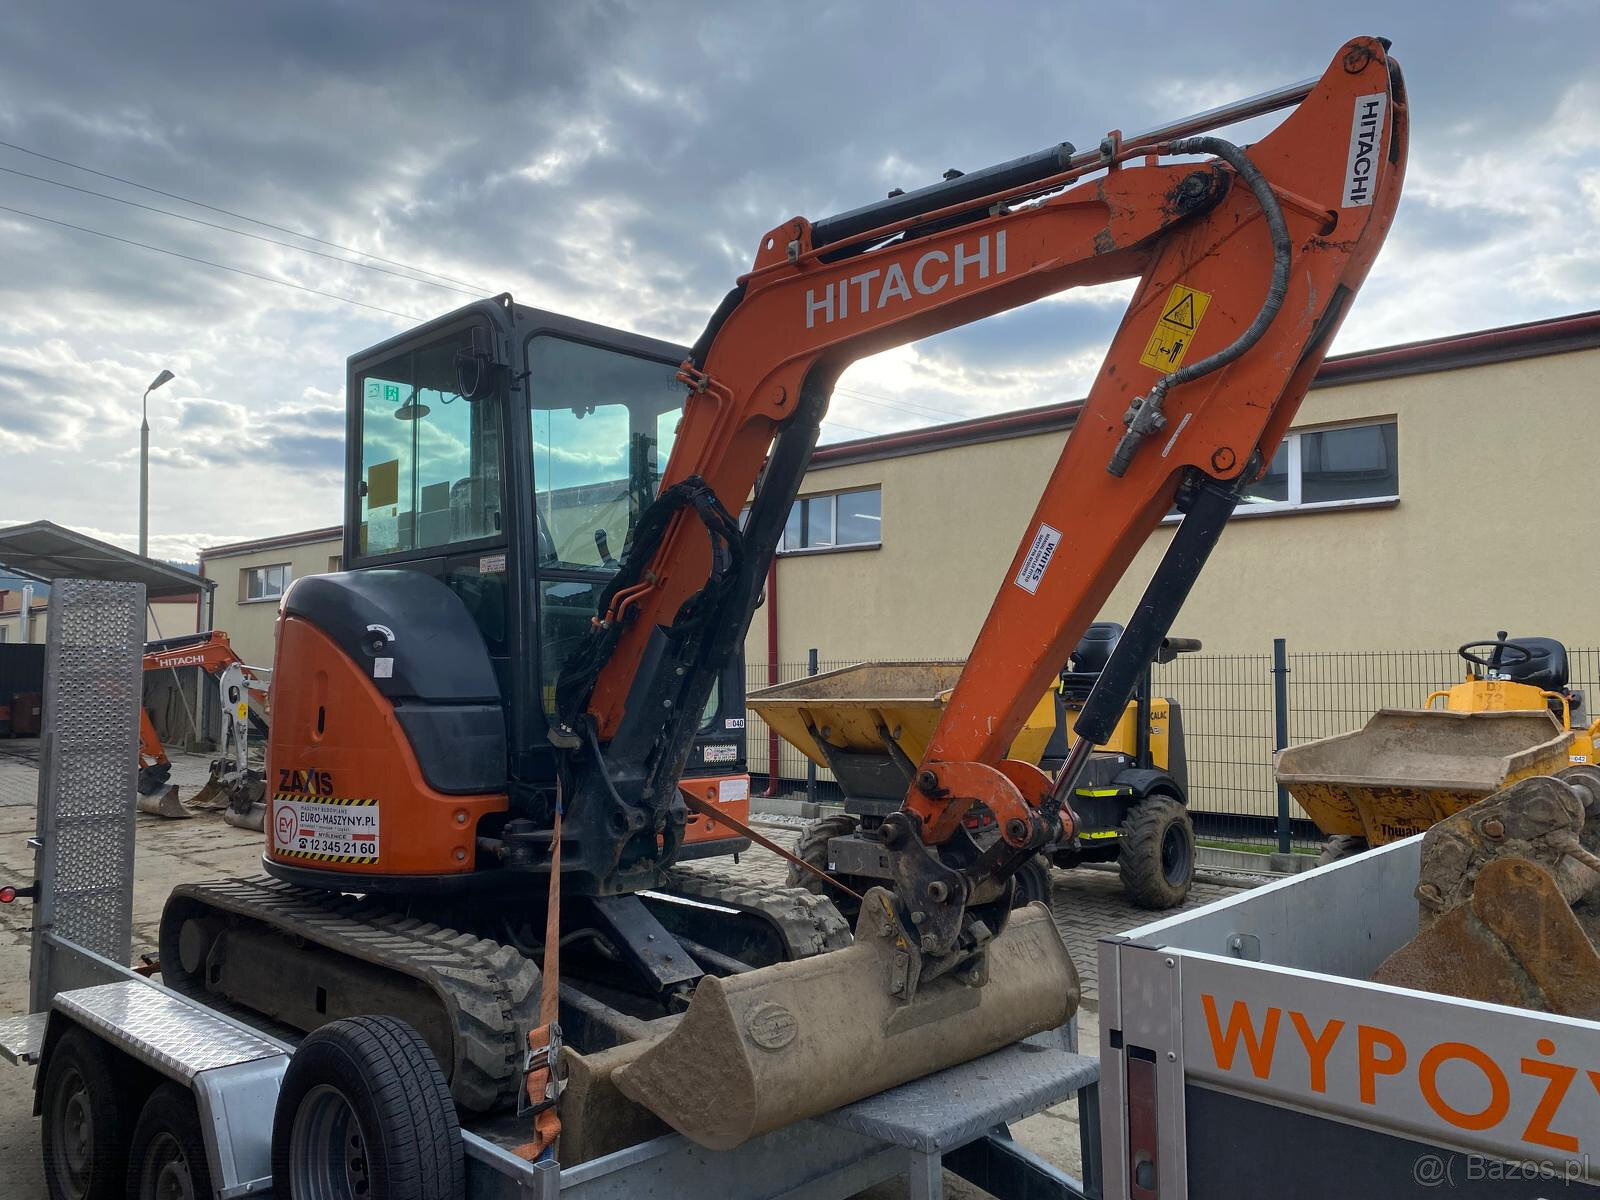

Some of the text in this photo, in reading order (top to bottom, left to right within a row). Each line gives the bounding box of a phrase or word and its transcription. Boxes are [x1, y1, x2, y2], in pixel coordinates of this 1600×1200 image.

[1350, 101, 1379, 201] HITACHI
[806, 229, 1007, 329] HITACHI
[1032, 543, 1055, 582] WHITES
[160, 655, 204, 667] HITACHI
[1150, 710, 1167, 720] CALAC
[732, 719, 744, 727] 040
[279, 768, 334, 796] ZAXIS
[300, 812, 376, 827] EURO-MASZYNY.PL
[1381, 824, 1427, 837] Thwait
[310, 839, 376, 854] 12 345 21 60
